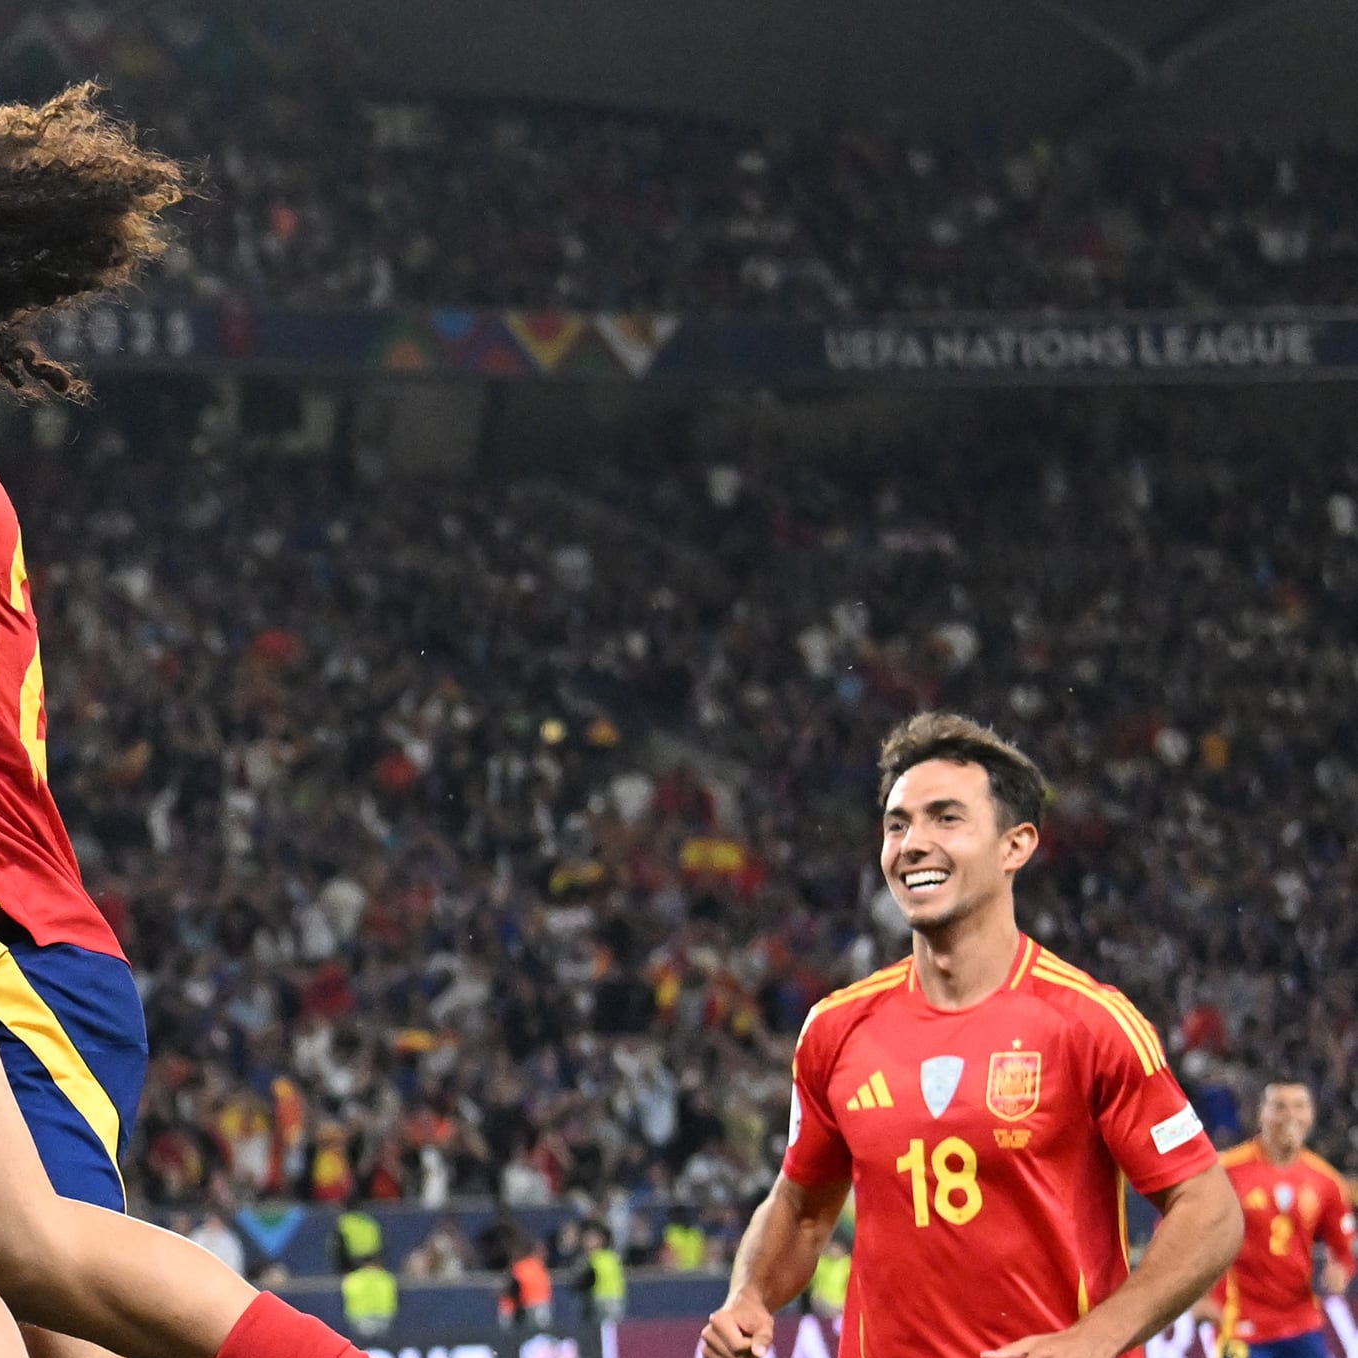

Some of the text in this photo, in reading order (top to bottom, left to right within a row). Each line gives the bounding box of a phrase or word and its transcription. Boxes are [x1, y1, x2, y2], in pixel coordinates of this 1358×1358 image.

[824, 323, 1315, 370] UEFA NATIONS LEAGUE
[896, 1135, 984, 1229] 18
